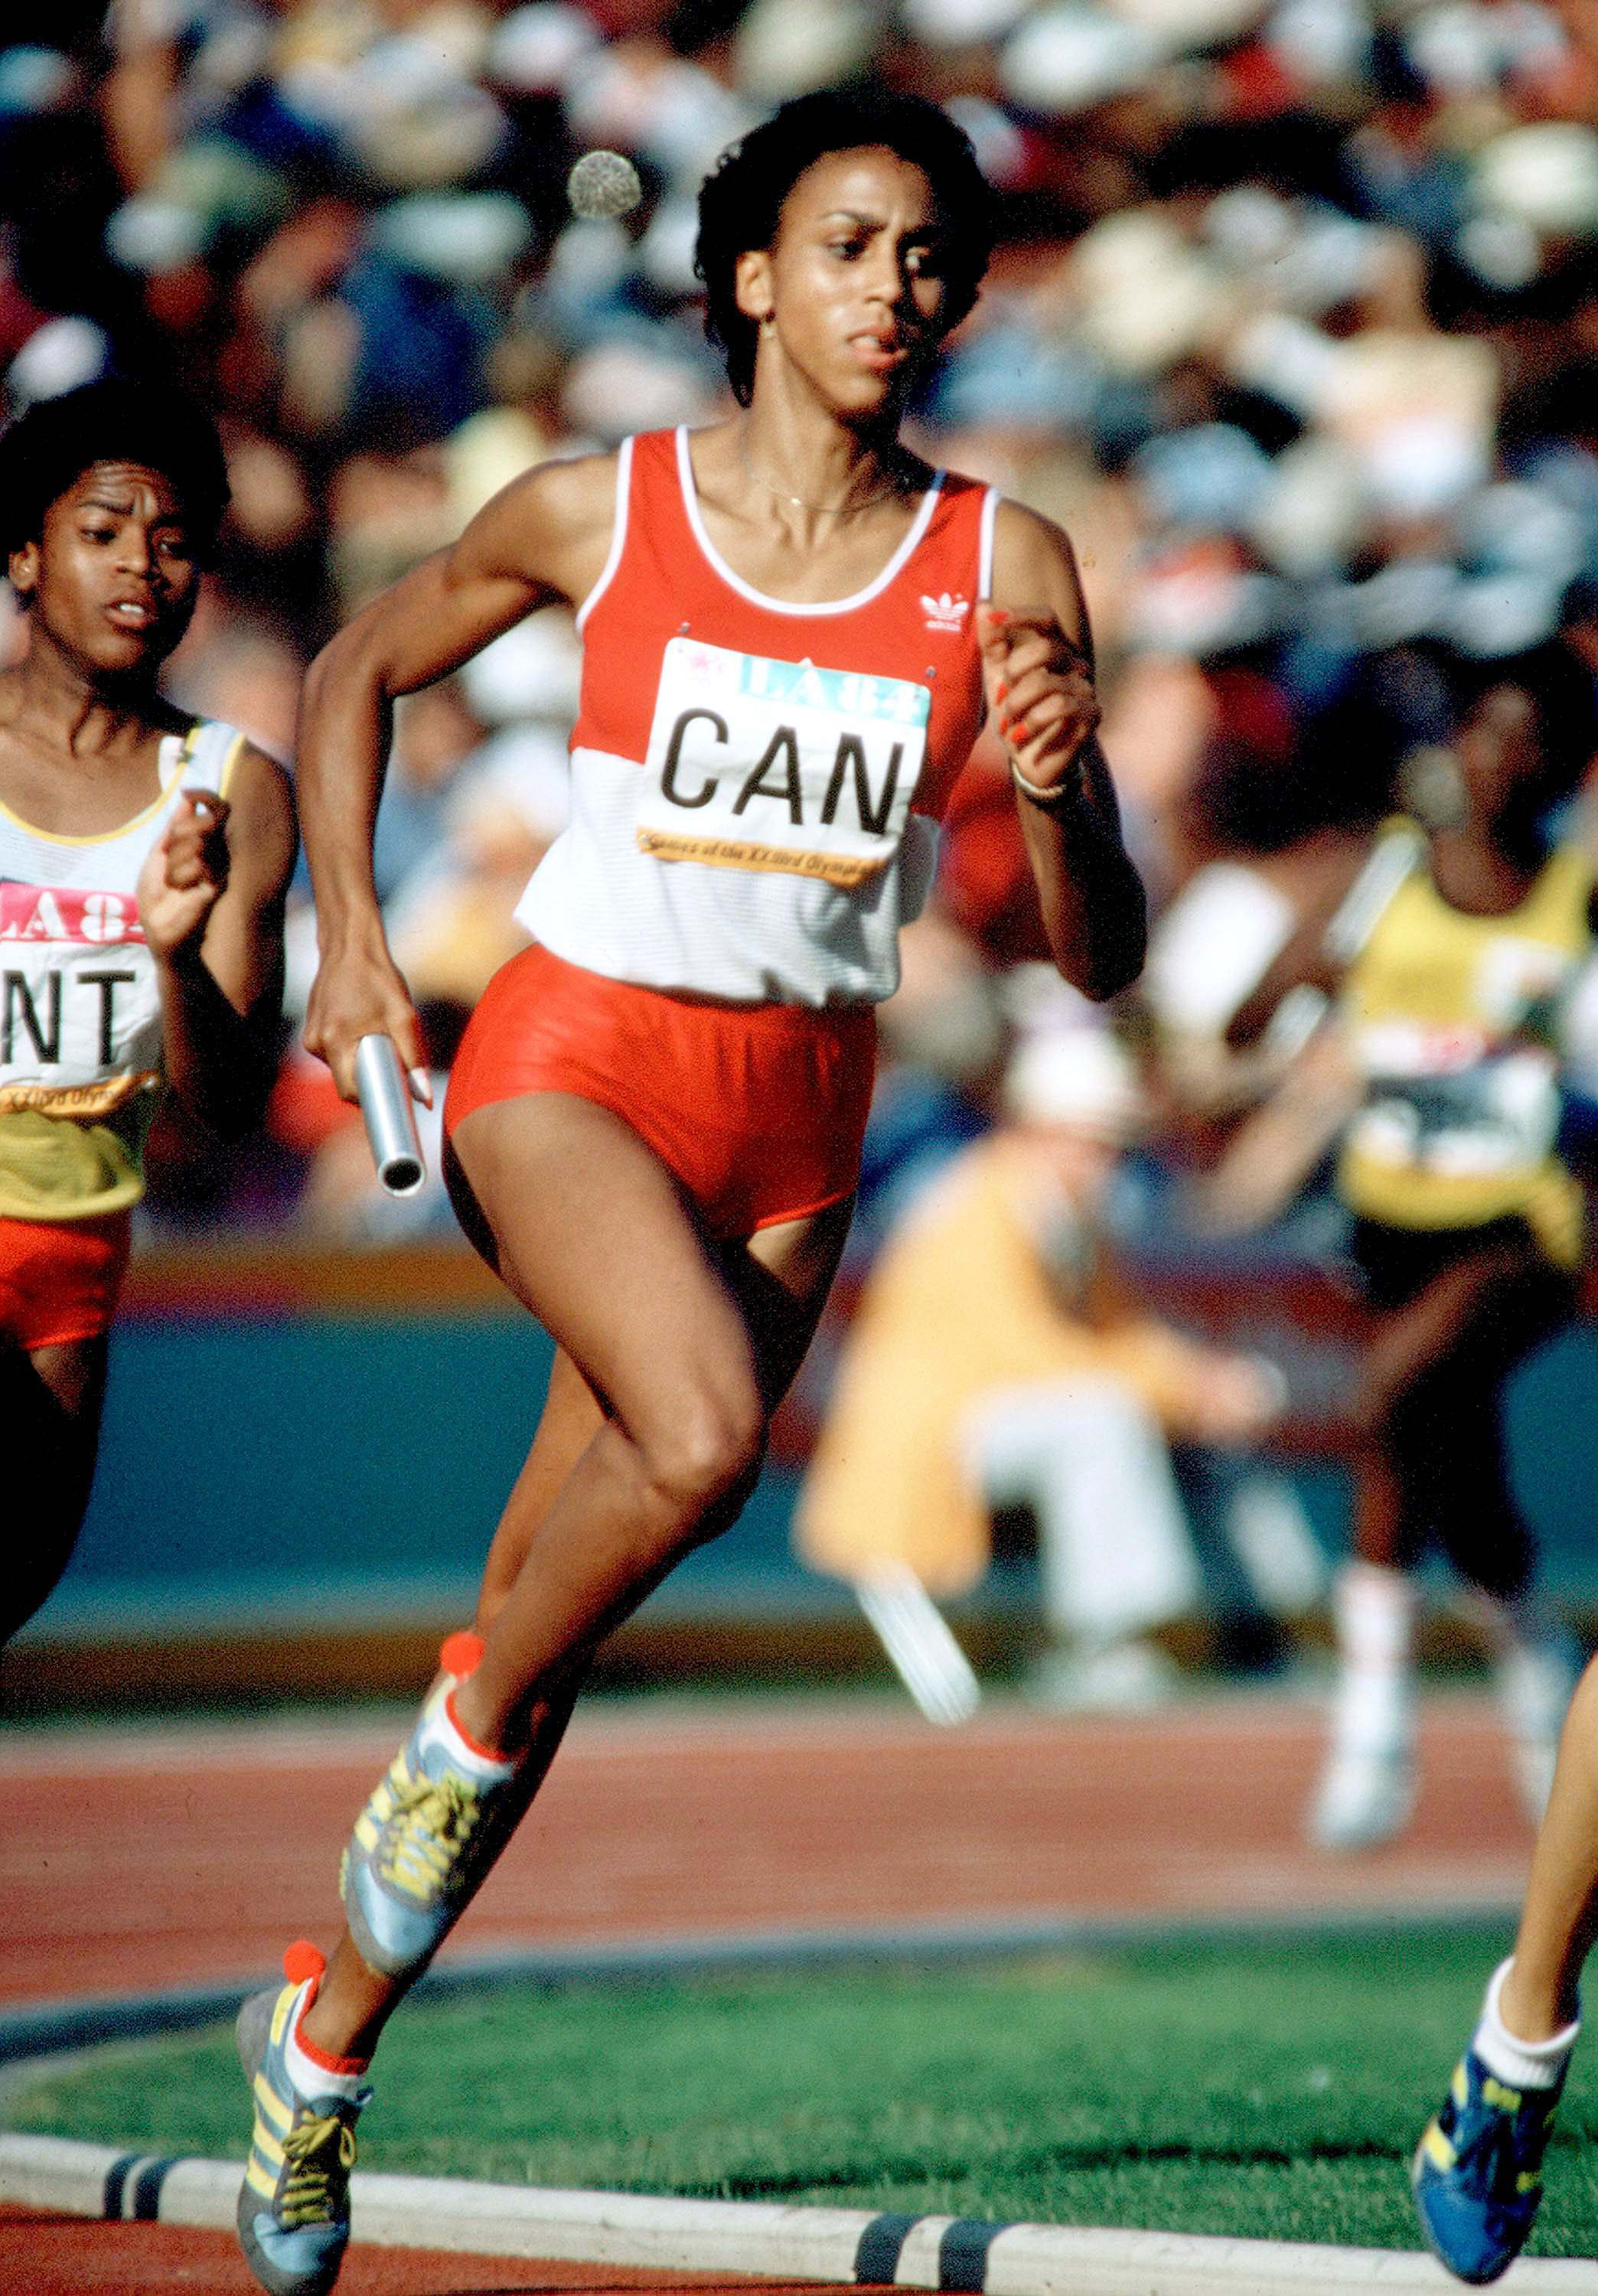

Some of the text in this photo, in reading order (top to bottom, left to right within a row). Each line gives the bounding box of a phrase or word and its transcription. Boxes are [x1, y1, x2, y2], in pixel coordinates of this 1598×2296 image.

[748, 657, 919, 723] LA84
[661, 707, 905, 836] CAN
[0, 890, 145, 942] A8
[0, 970, 136, 1066] NT
